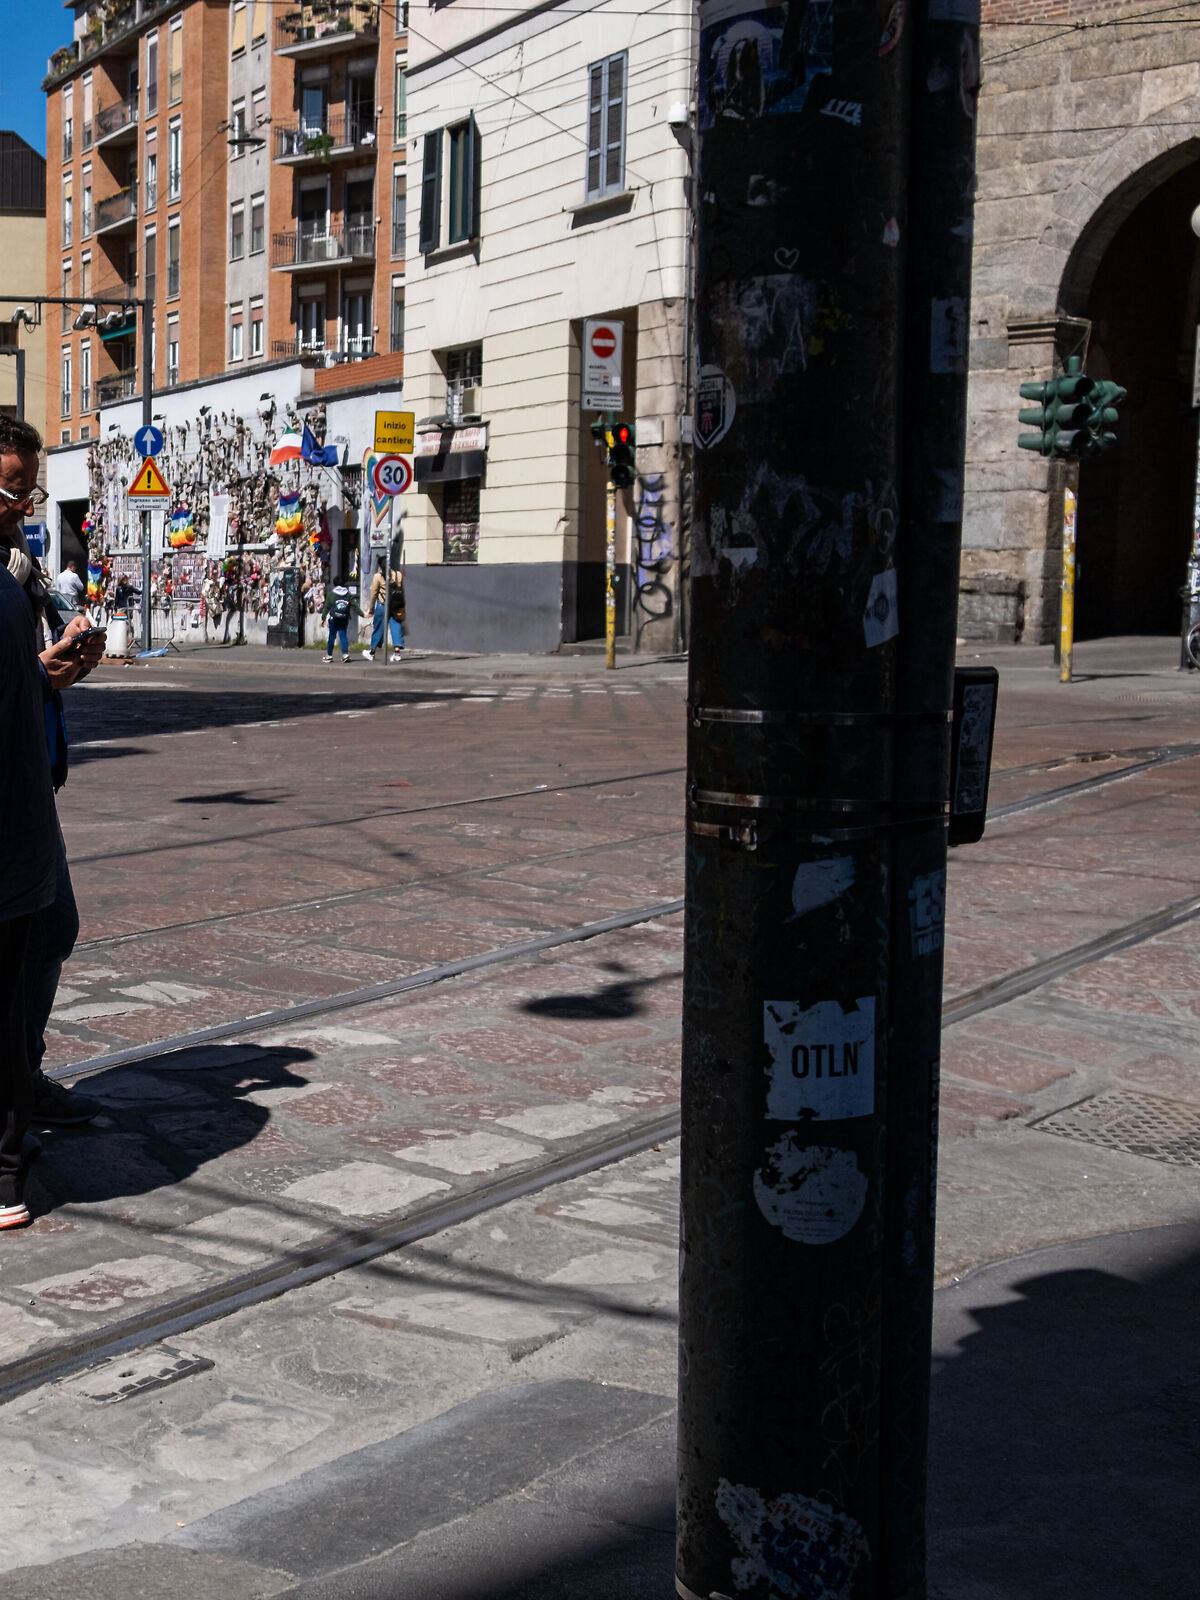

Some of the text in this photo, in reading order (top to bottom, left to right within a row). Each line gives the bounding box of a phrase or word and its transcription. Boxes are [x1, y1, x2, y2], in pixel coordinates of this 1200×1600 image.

[383, 421, 407, 430] inizio
[376, 436, 412, 445] cantiere
[382, 465, 404, 485] 30
[791, 1042, 858, 1078] OTLN
